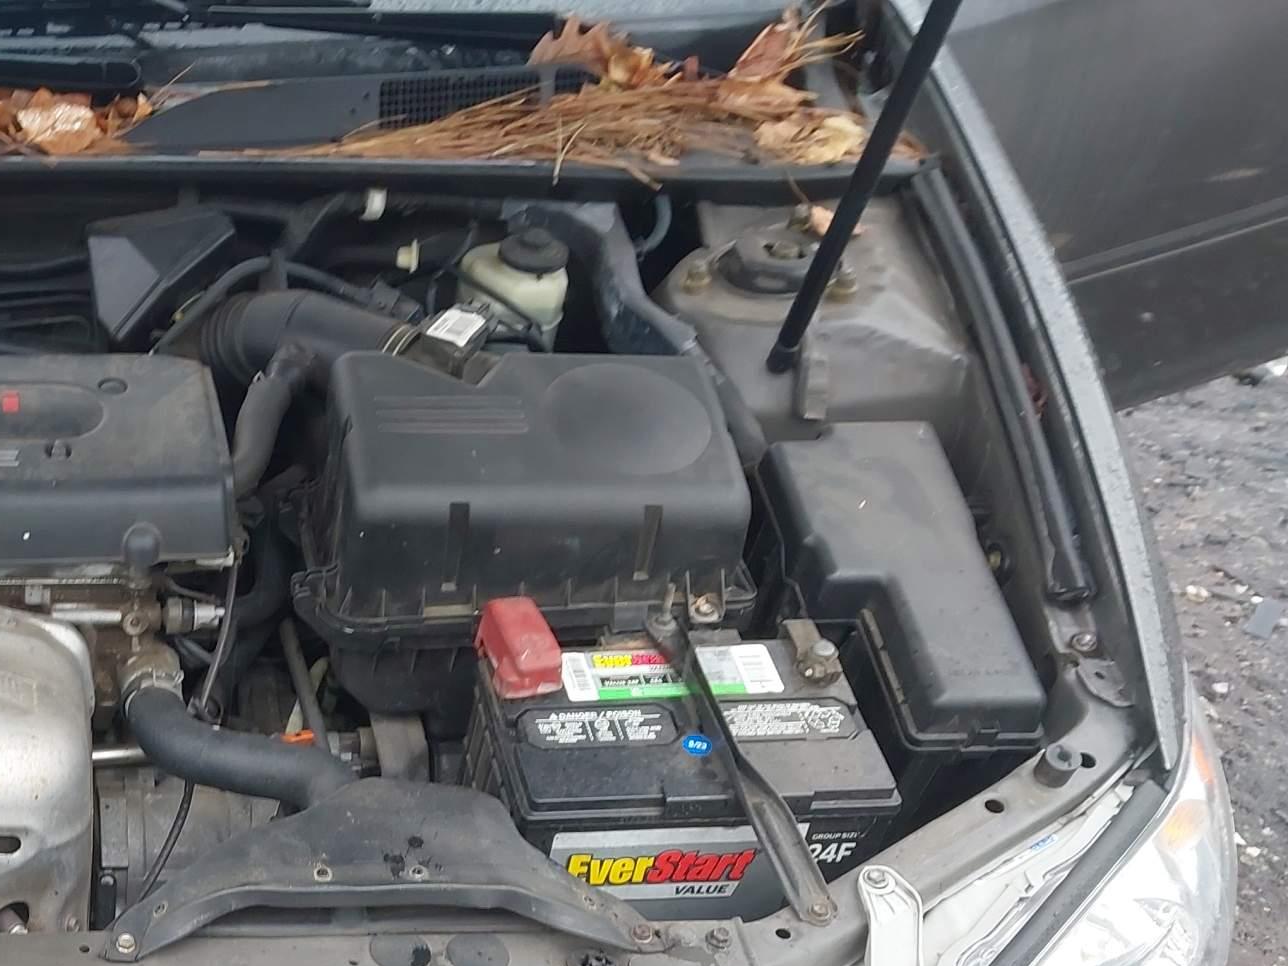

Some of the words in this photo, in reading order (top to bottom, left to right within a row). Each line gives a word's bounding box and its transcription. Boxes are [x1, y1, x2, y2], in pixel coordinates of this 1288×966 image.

[812, 832, 842, 840] GROUP
[809, 842, 856, 863] 24F
[567, 848, 757, 886] EverStart
[674, 884, 730, 896] VALUE
